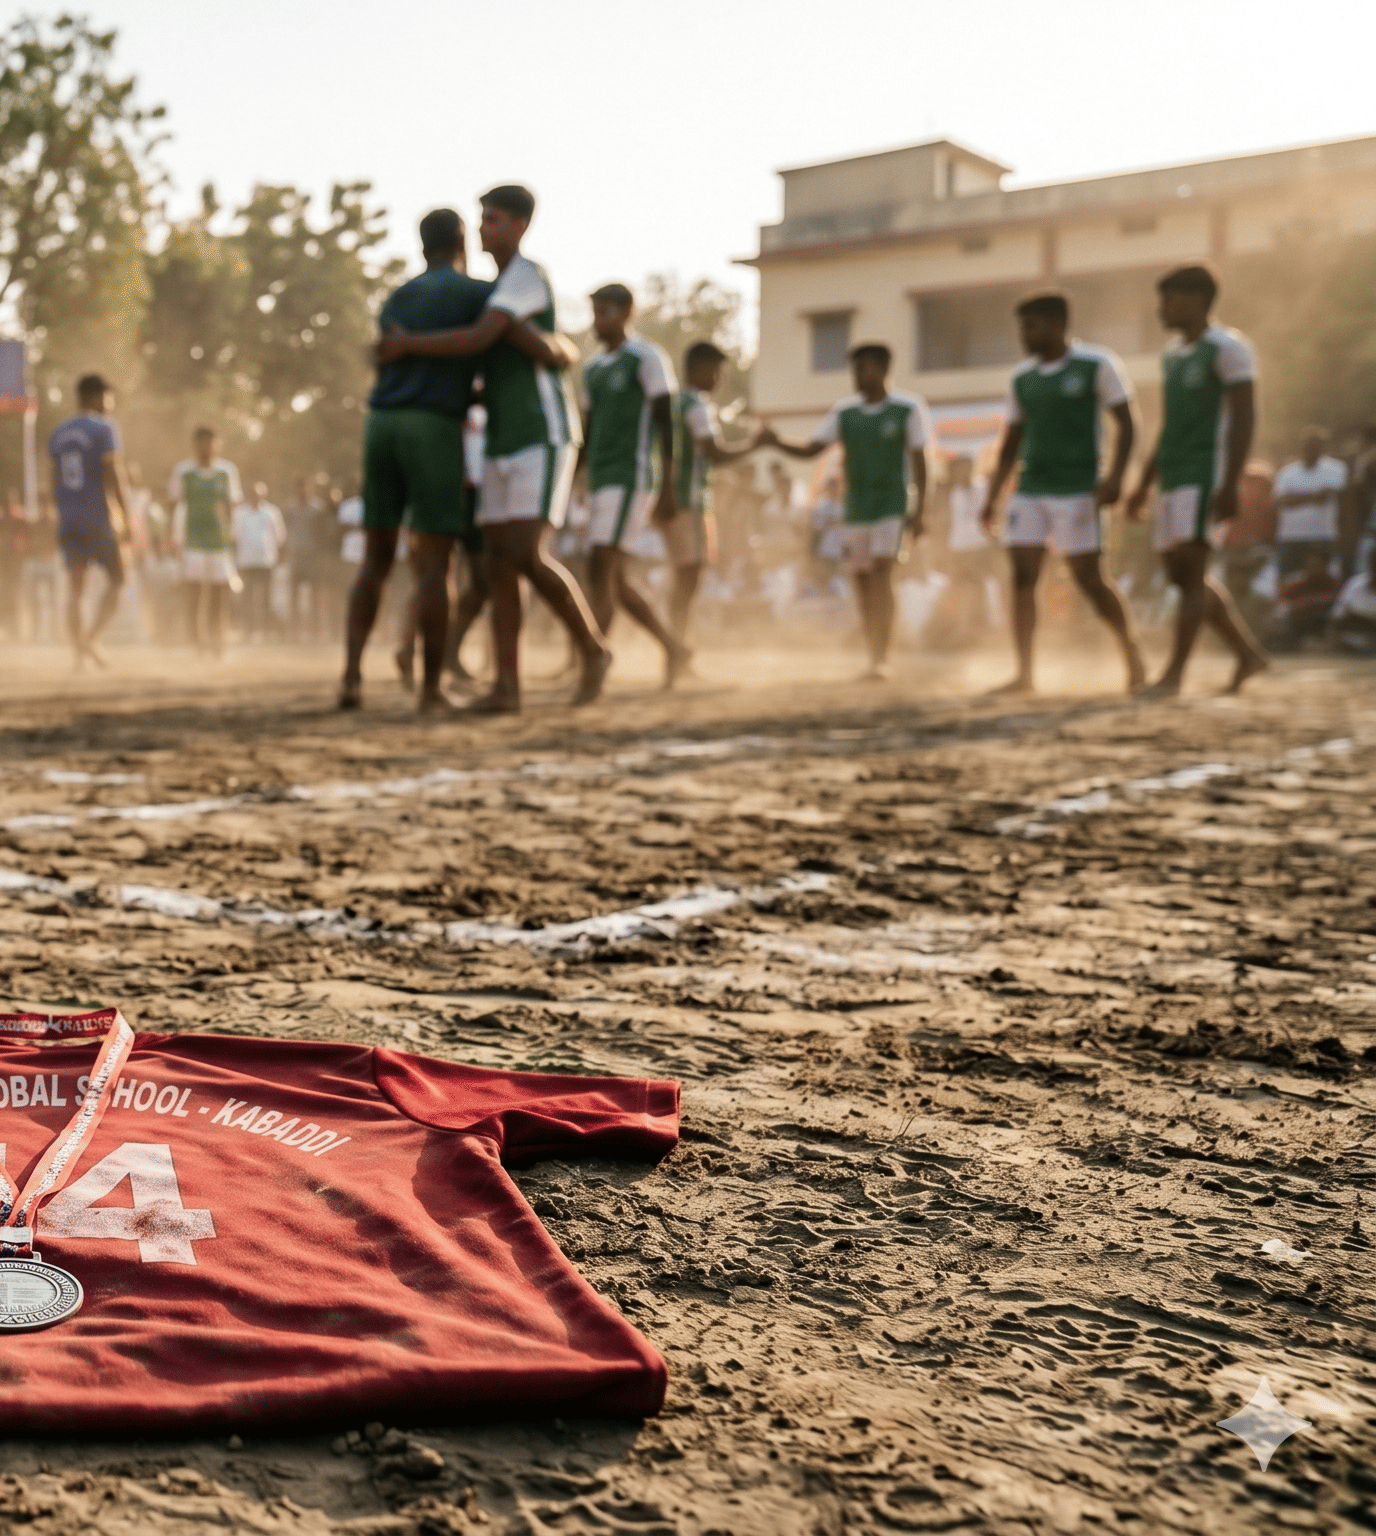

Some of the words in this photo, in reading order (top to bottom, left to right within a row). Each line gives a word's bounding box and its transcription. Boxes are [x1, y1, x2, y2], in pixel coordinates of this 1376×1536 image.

[75, 1075, 192, 1118] SHOOL
[197, 1105, 211, 1115] -
[210, 1097, 352, 1157] KABADDI
